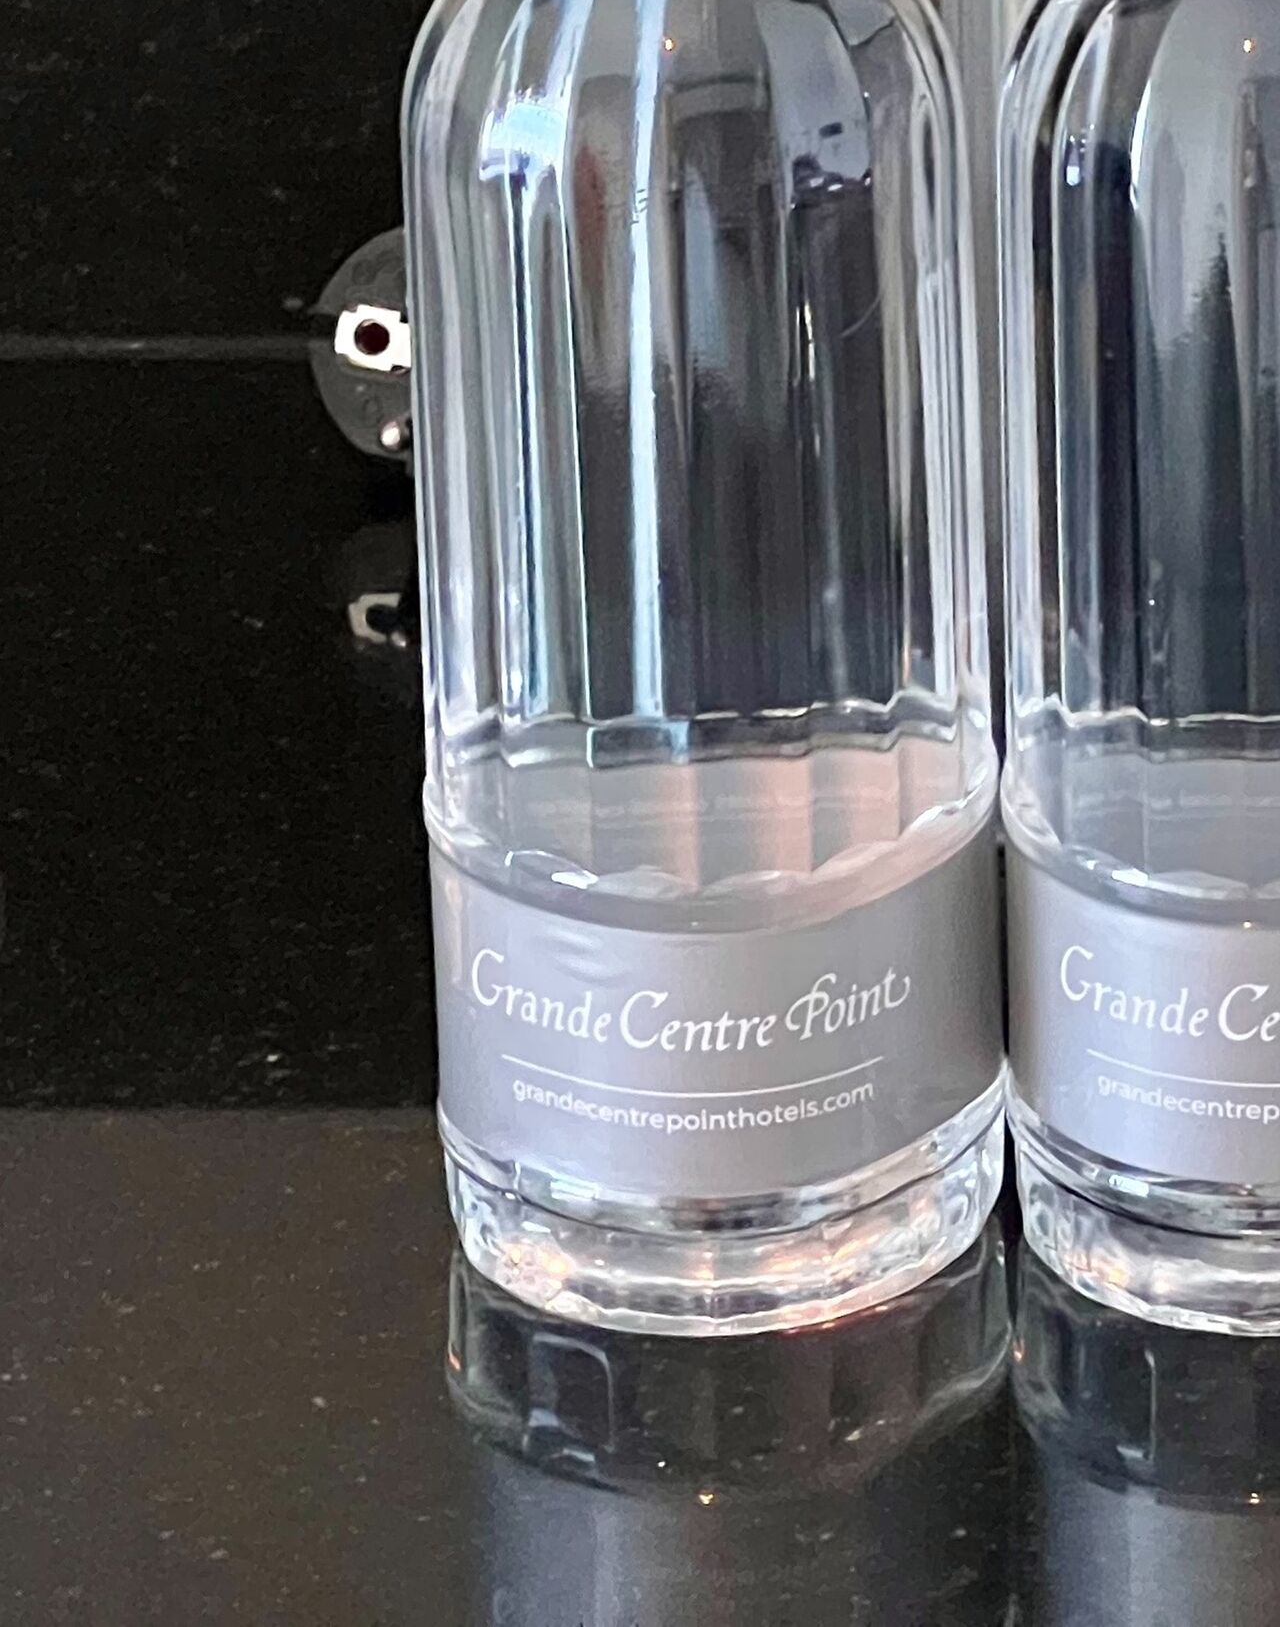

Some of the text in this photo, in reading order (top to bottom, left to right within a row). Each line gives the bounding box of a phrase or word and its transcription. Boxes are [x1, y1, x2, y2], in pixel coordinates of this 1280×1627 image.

[470, 947, 912, 1052] Grande Centre Point
[1058, 944, 1207, 1039] Grande
[512, 1077, 876, 1135] grandecentrepointhotels.com
